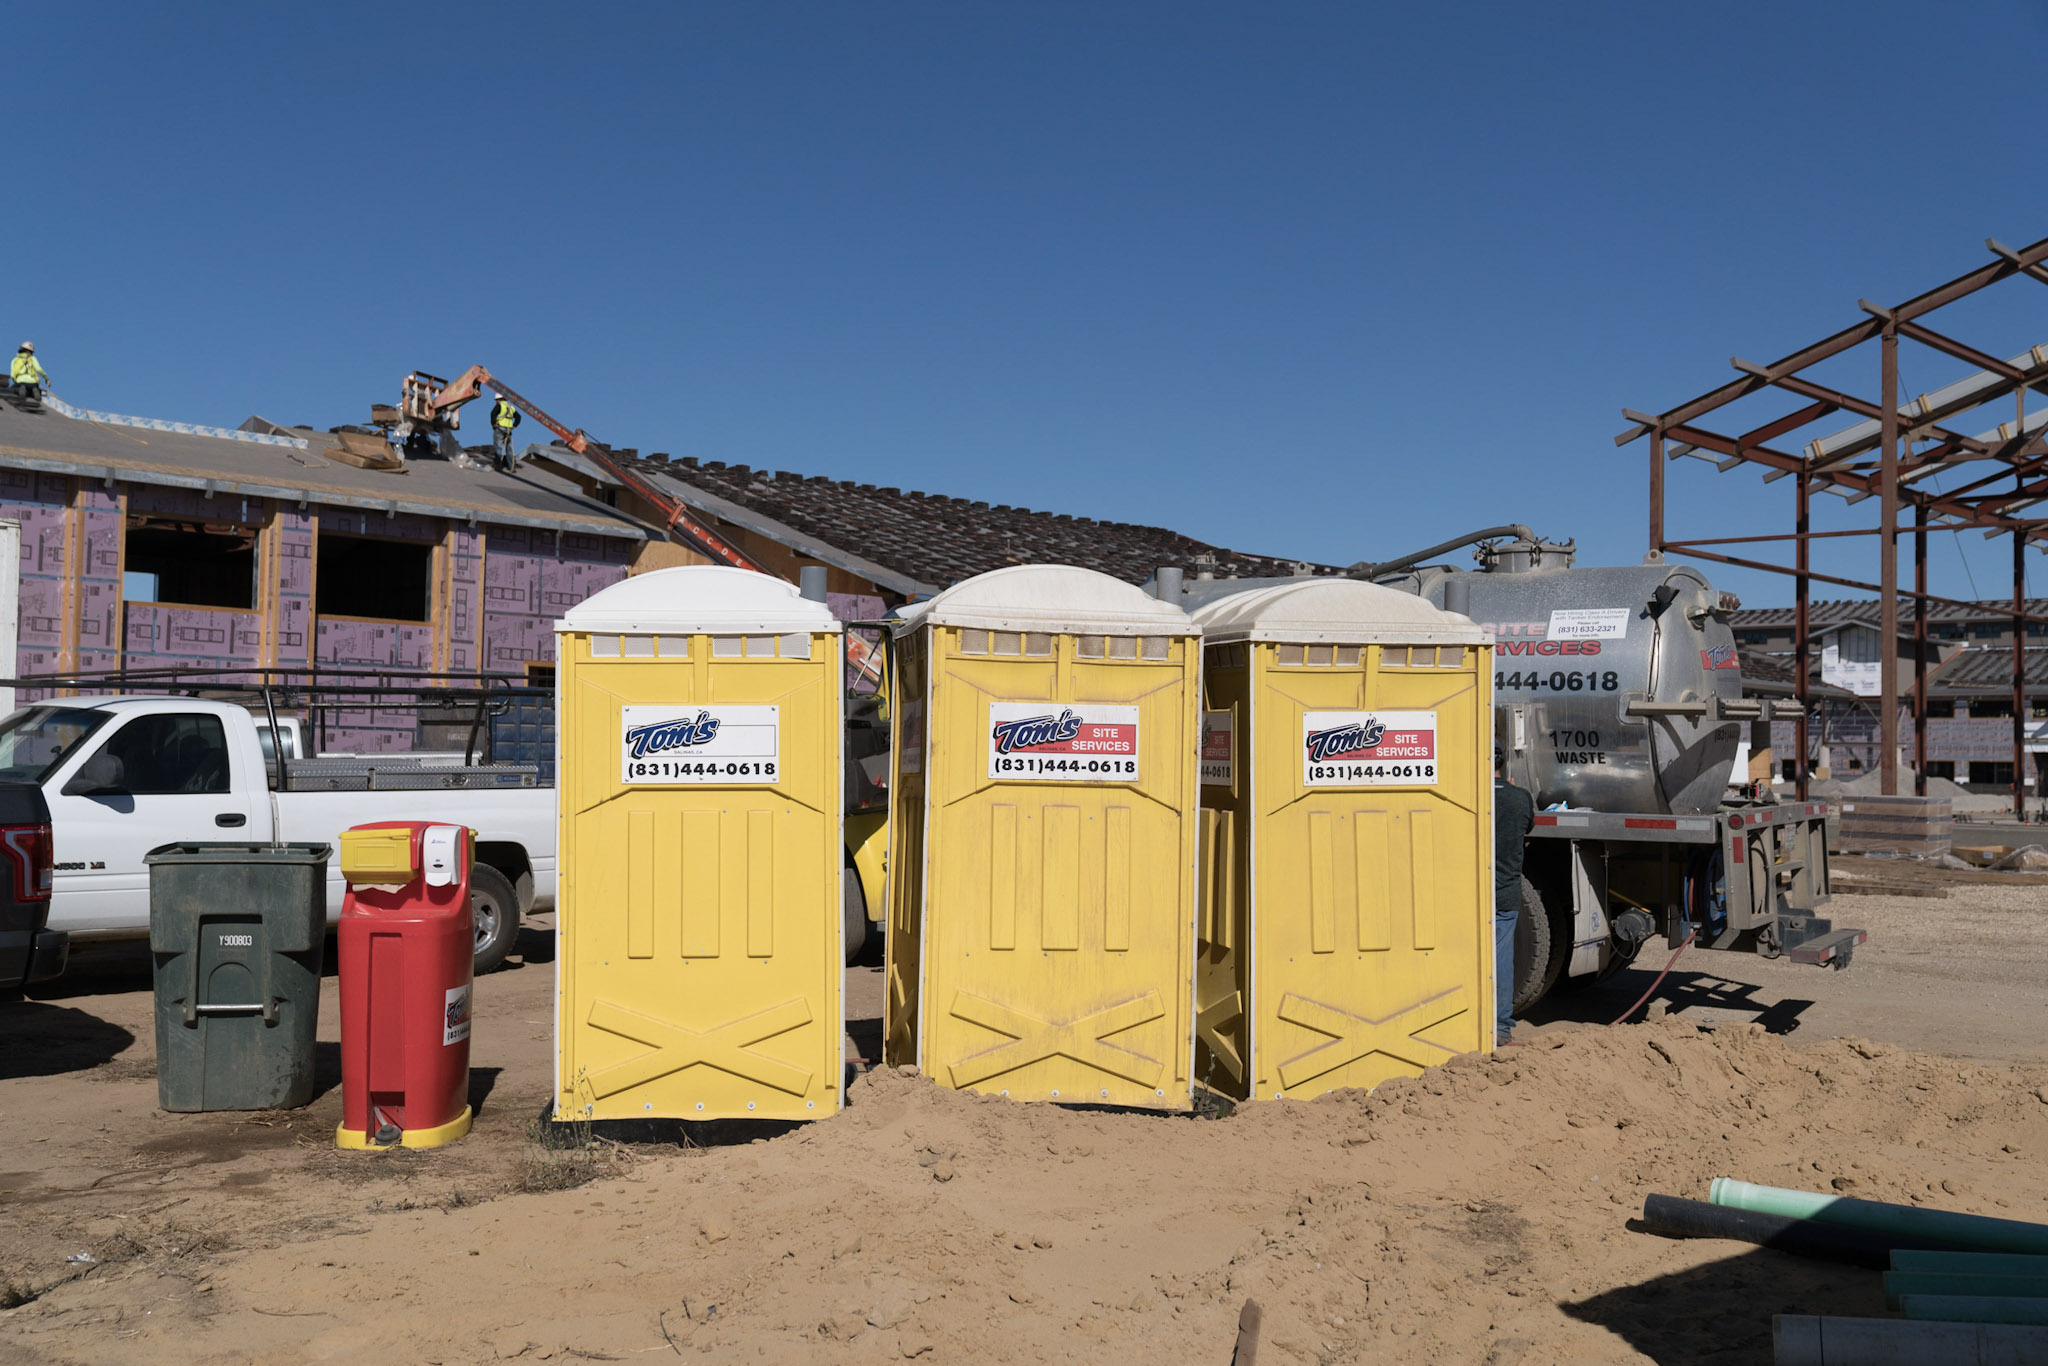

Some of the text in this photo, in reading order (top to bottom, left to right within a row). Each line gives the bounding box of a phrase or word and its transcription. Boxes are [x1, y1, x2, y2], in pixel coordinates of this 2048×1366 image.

[1558, 625, 1616, 634] (831) 633-2321
[626, 711, 720, 760] Tom's
[993, 709, 1083, 755] Tom's
[1092, 728, 1119, 738] SITE
[1306, 717, 1386, 763] Tom's
[1394, 734, 1418, 744] SITE
[1549, 731, 1600, 747] 1700
[1071, 741, 1130, 751] SERVICES
[1376, 747, 1429, 757] SERVICES
[1556, 752, 1606, 764] WASTE
[628, 762, 776, 778] (831)444-0618
[995, 758, 1136, 773] (831)444-0618
[1309, 765, 1434, 781] (831)444-0618
[219, 935, 253, 946] Y900803
